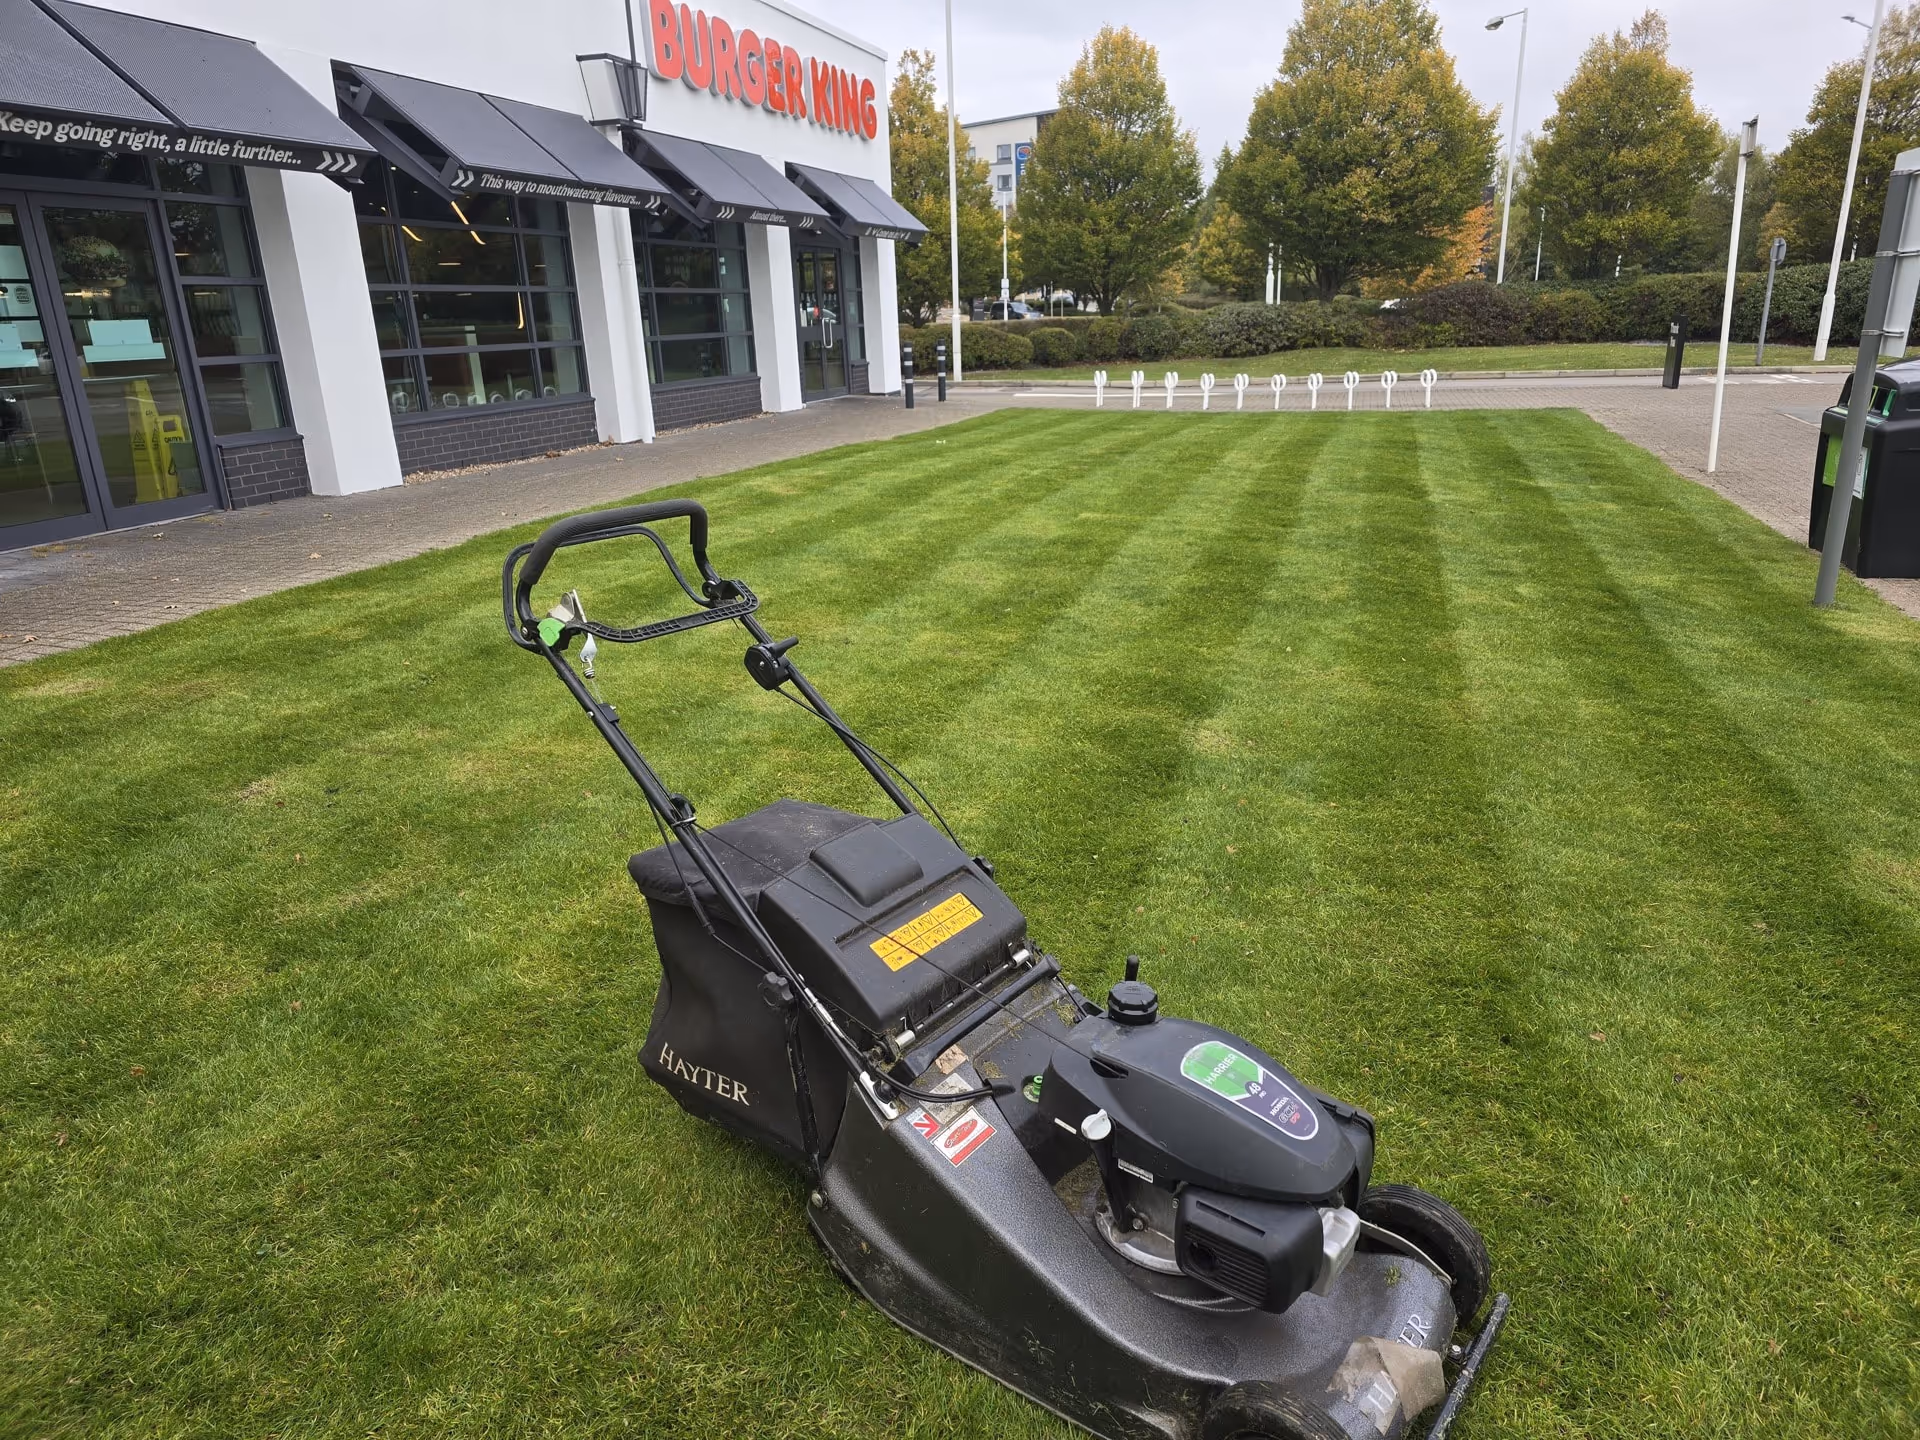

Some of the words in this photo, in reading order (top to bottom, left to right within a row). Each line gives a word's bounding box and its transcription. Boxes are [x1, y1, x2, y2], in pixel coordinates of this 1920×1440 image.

[648, 0, 807, 119] BURGER
[811, 56, 878, 140] KING
[0, 111, 53, 140] Keep
[54, 121, 117, 148] going
[118, 127, 171, 153] right,
[174, 137, 187, 152] a
[188, 135, 230, 157] little
[231, 140, 302, 165] further...
[480, 173, 503, 189] This
[504, 180, 525, 194] way
[525, 181, 538, 193] to
[536, 183, 607, 203] mouthwatering
[658, 1041, 750, 1107] HAYTER
[1203, 1053, 1239, 1085] HARRIER
[1248, 1082, 1262, 1096] 48
[1270, 1096, 1290, 1116] HONDA
